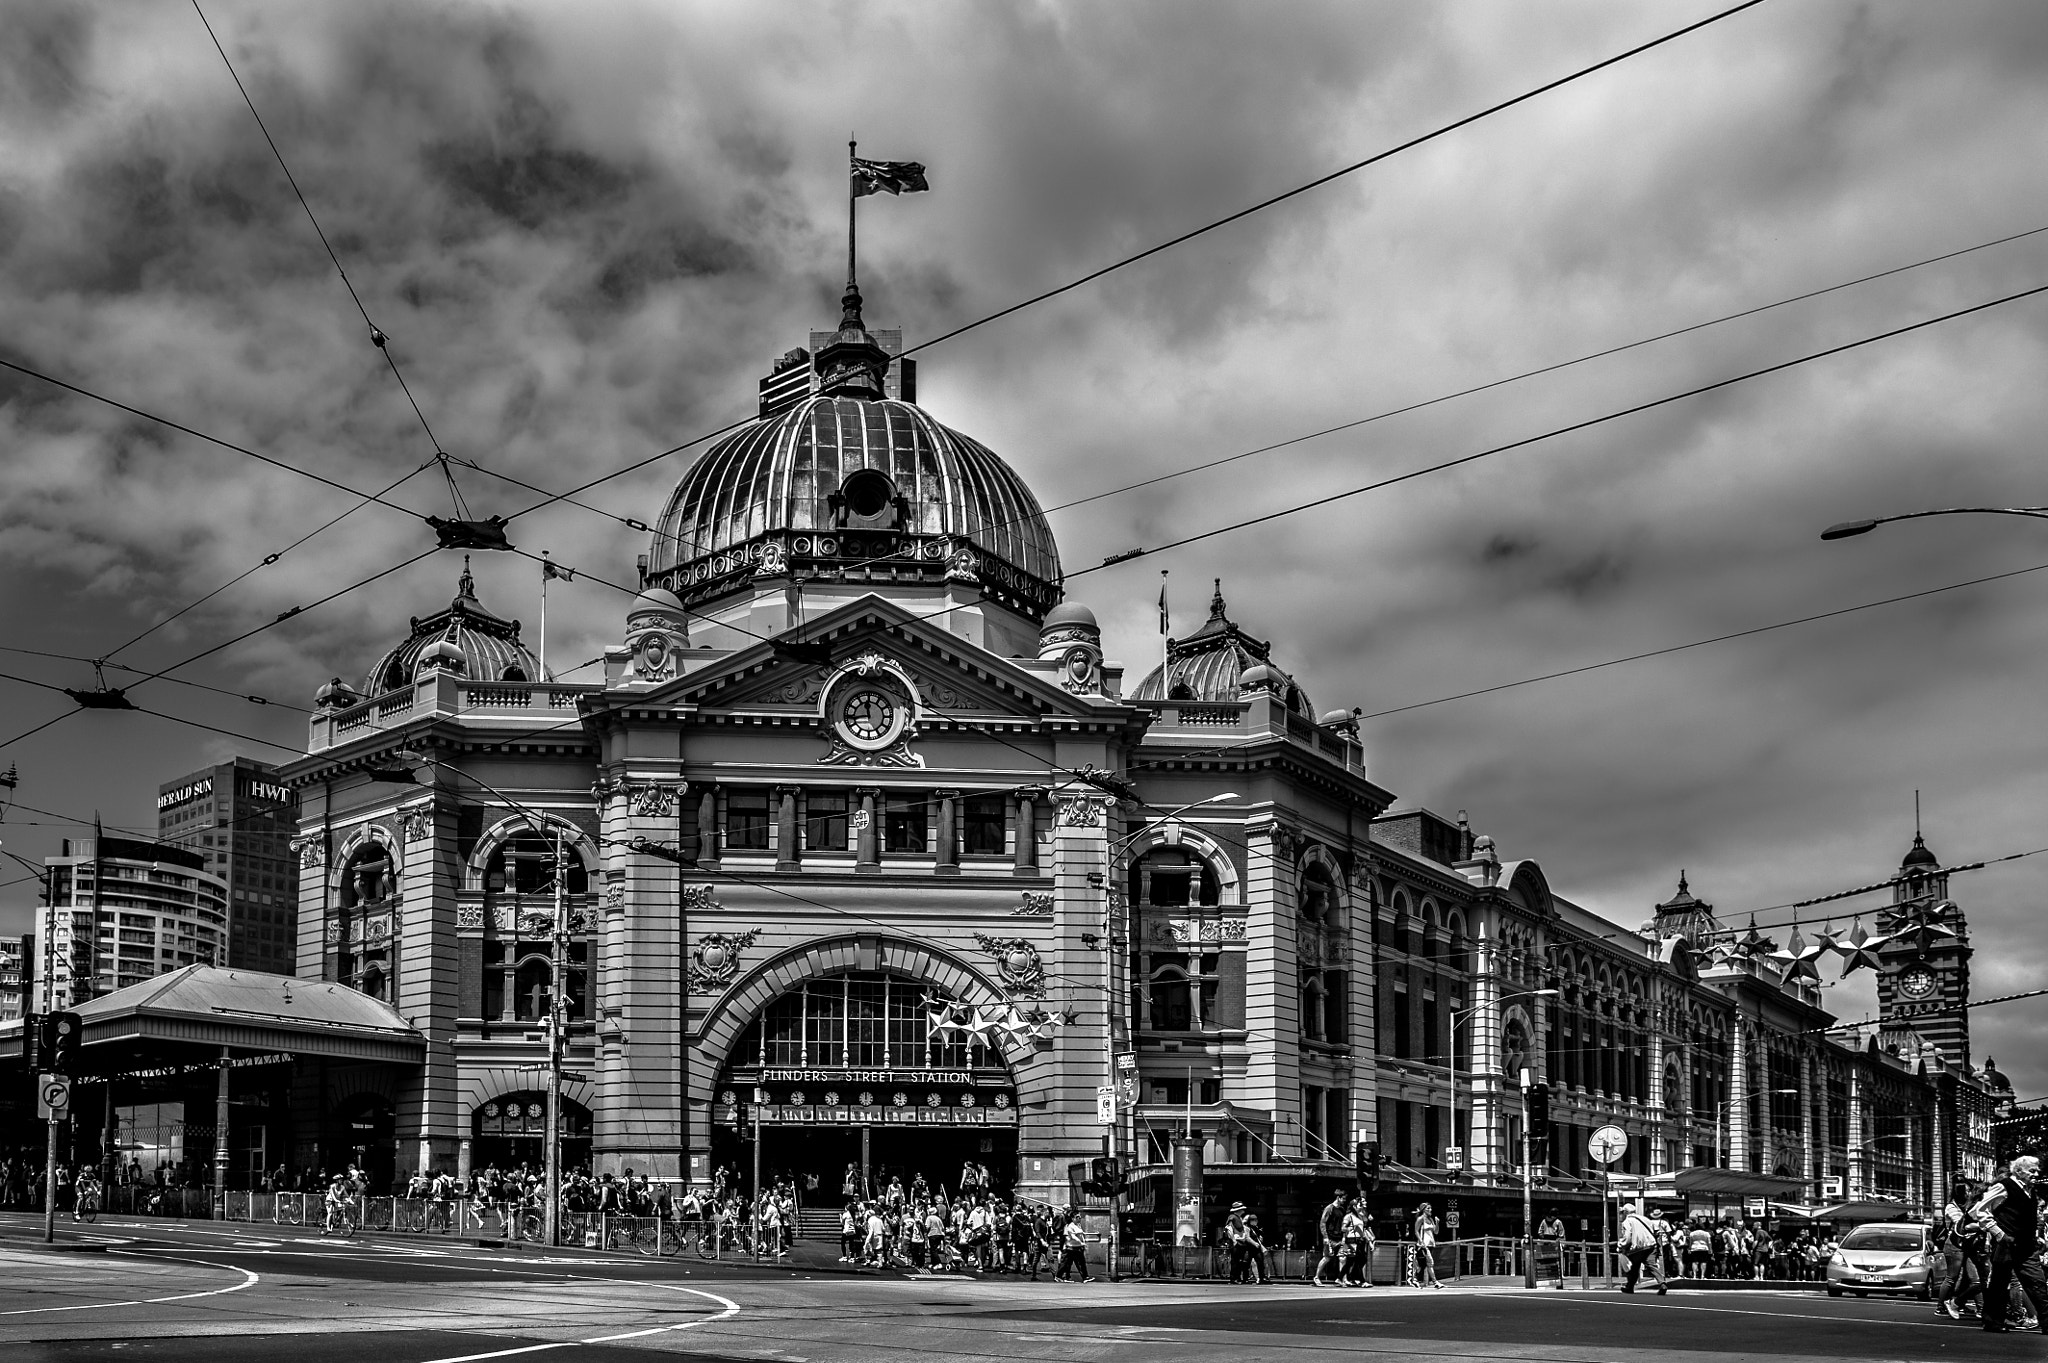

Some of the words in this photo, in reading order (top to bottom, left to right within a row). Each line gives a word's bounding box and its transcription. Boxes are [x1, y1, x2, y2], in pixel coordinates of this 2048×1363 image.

[157, 786, 192, 809] HERALD
[193, 778, 213, 796] SUN
[251, 780, 291, 803] HWT
[855, 812, 867, 820] CUT
[856, 820, 868, 828] OFF
[763, 1069, 828, 1082] FLINDERS
[845, 1071, 895, 1083] STREET
[911, 1072, 971, 1083] STATION
